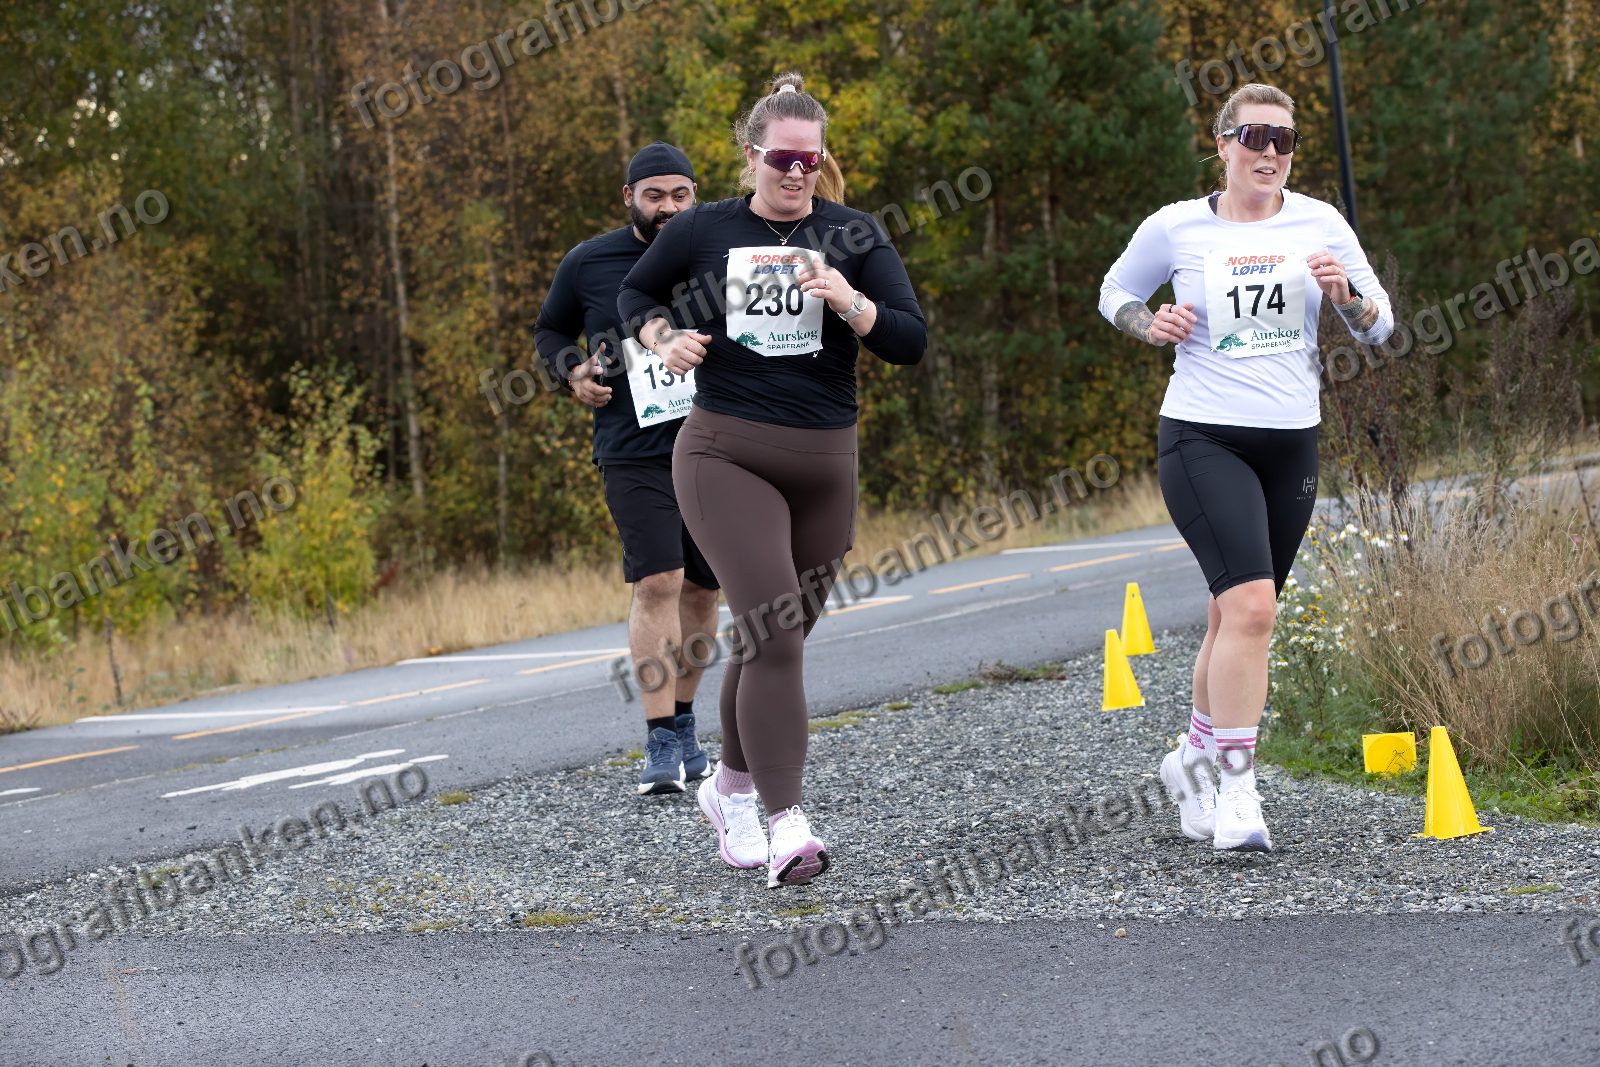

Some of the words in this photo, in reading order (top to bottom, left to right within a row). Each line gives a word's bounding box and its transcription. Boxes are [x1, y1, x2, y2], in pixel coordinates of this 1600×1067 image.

[750, 254, 808, 265] NORGES
[1226, 255, 1286, 266] NORGES
[754, 264, 799, 275] LØPET
[1231, 264, 1277, 276] LØPET
[745, 282, 804, 317] 230
[1226, 283, 1286, 319] 174
[767, 329, 819, 343] Aurskog
[1250, 327, 1301, 342] Aurskog
